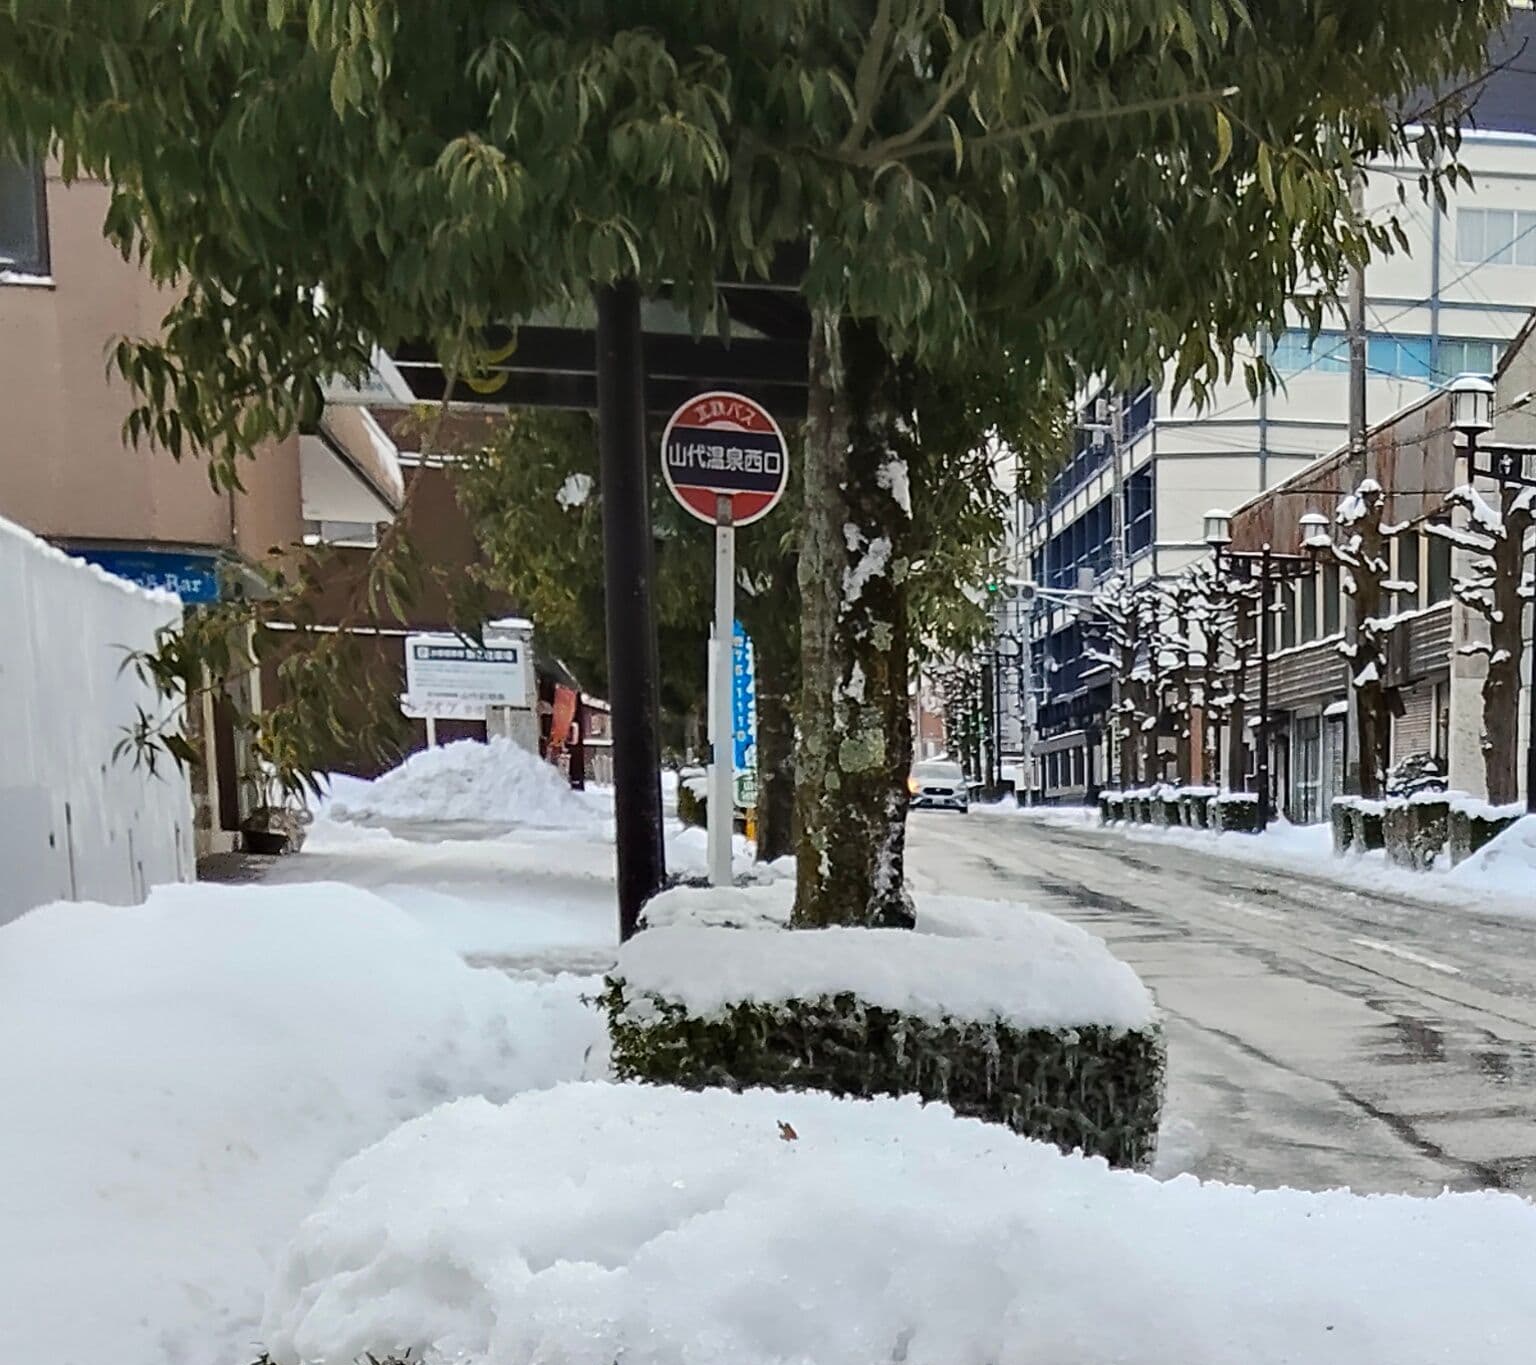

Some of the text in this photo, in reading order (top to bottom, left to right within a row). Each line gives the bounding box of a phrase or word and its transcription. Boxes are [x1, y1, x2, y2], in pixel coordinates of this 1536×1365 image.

[668, 442, 781, 475] 山代温泉西口
